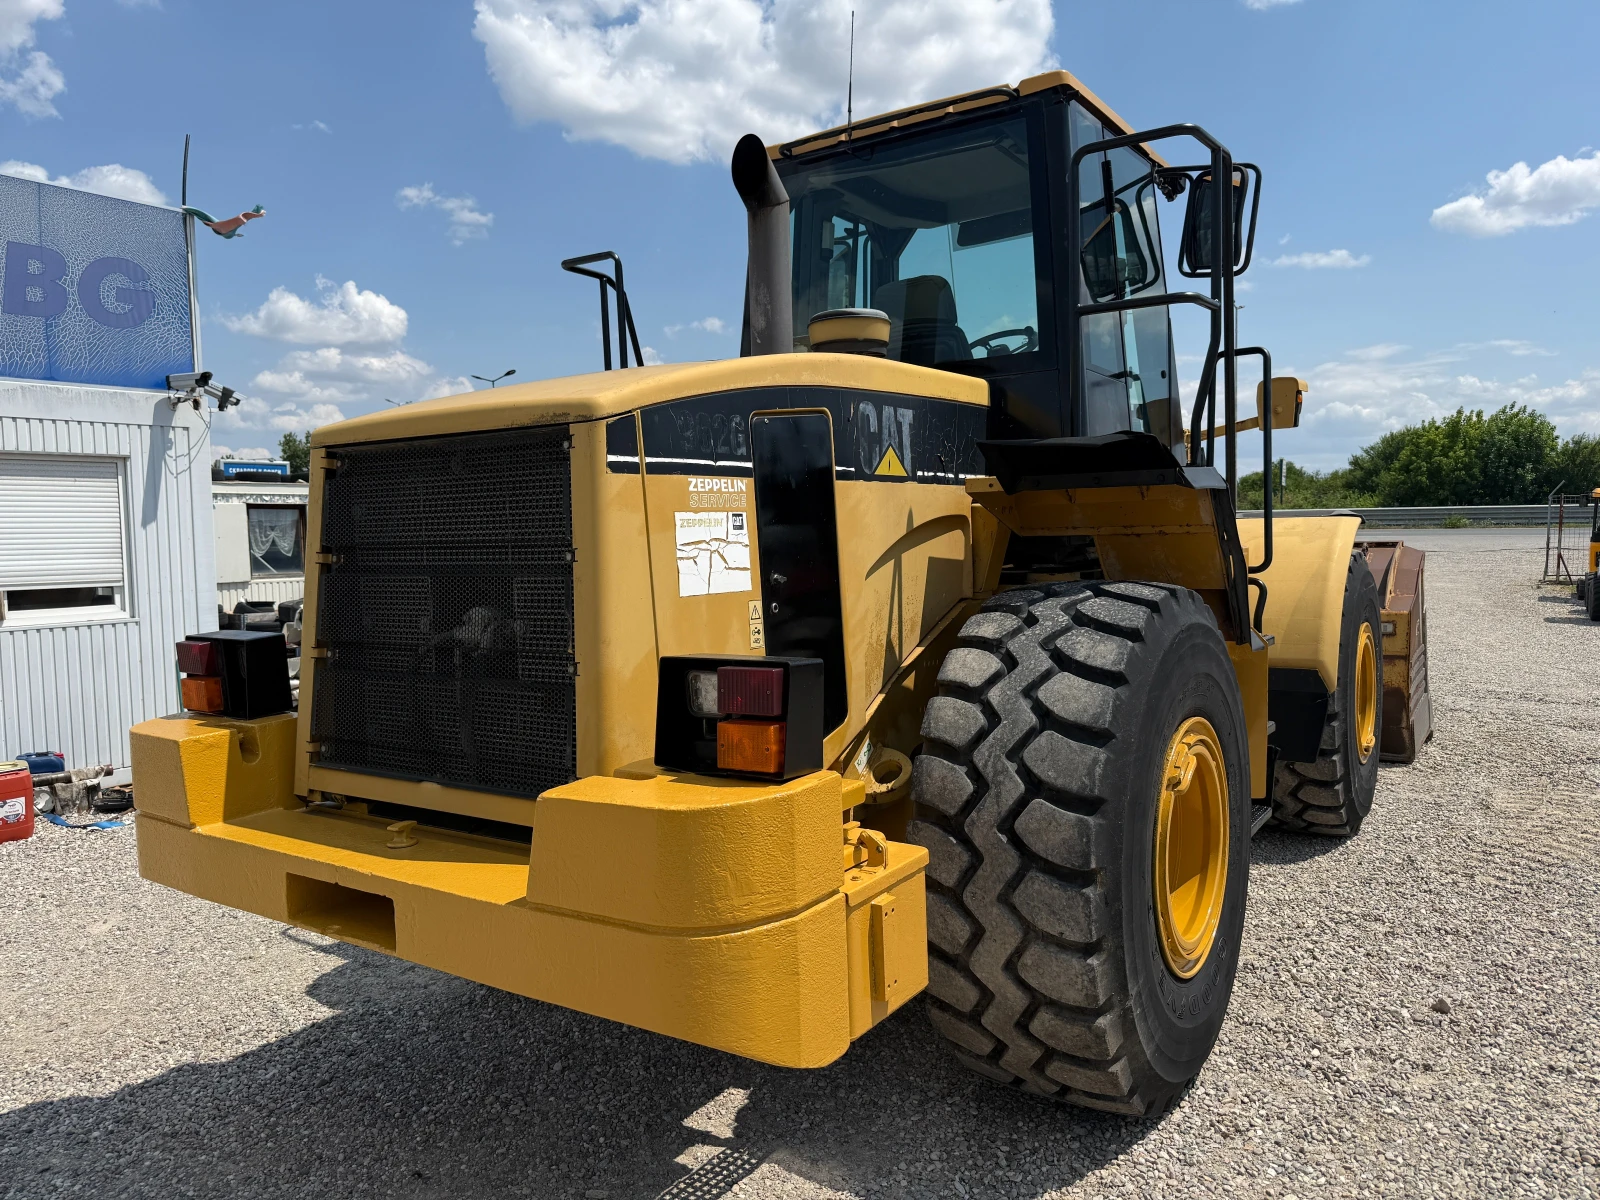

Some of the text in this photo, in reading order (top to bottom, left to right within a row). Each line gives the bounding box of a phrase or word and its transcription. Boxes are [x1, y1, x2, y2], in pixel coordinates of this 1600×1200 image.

[2, 241, 156, 329] BG
[858, 401, 914, 475] CAT
[689, 493, 747, 508] SERVICE
[732, 516, 743, 525] CAT
